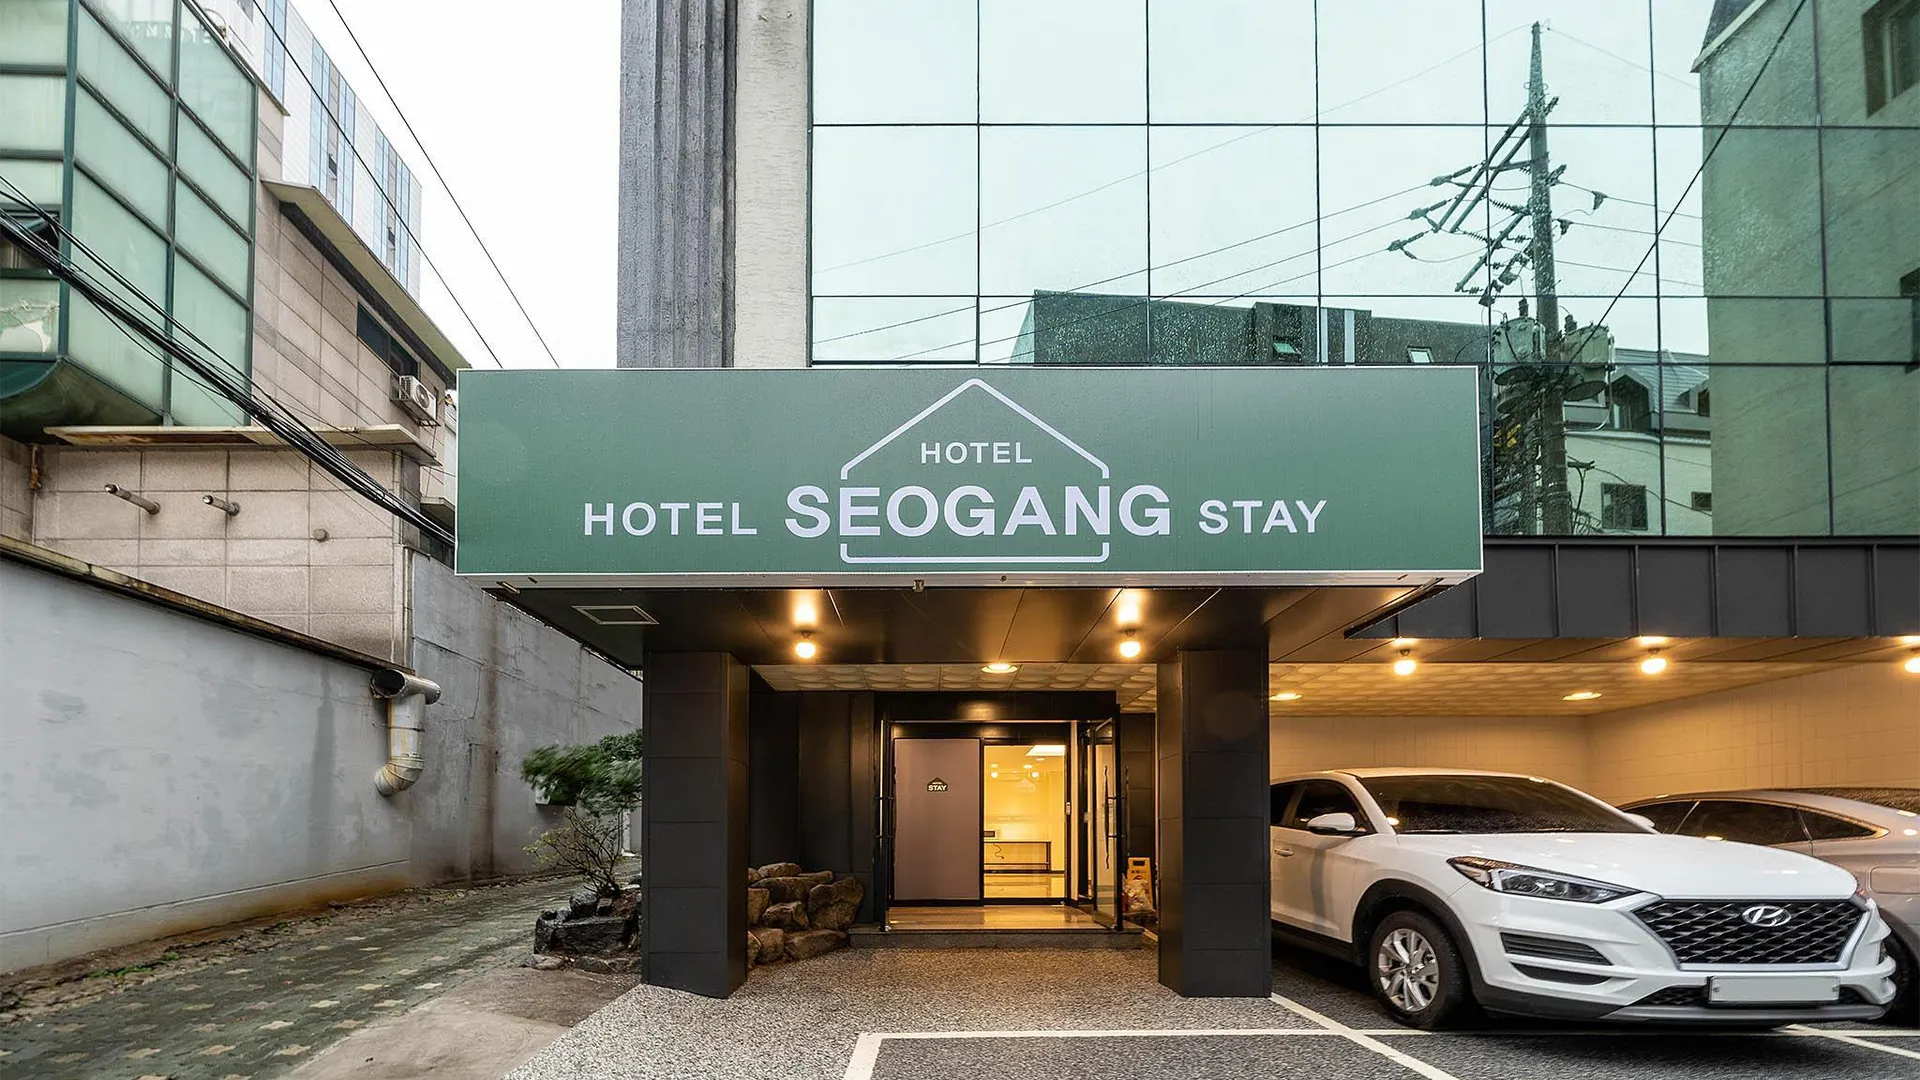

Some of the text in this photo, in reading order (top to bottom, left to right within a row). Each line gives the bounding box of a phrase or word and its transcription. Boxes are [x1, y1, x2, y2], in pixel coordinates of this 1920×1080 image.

[920, 441, 1033, 464] HOTEL
[583, 485, 1328, 538] HOTEL SEOGANG STAY
